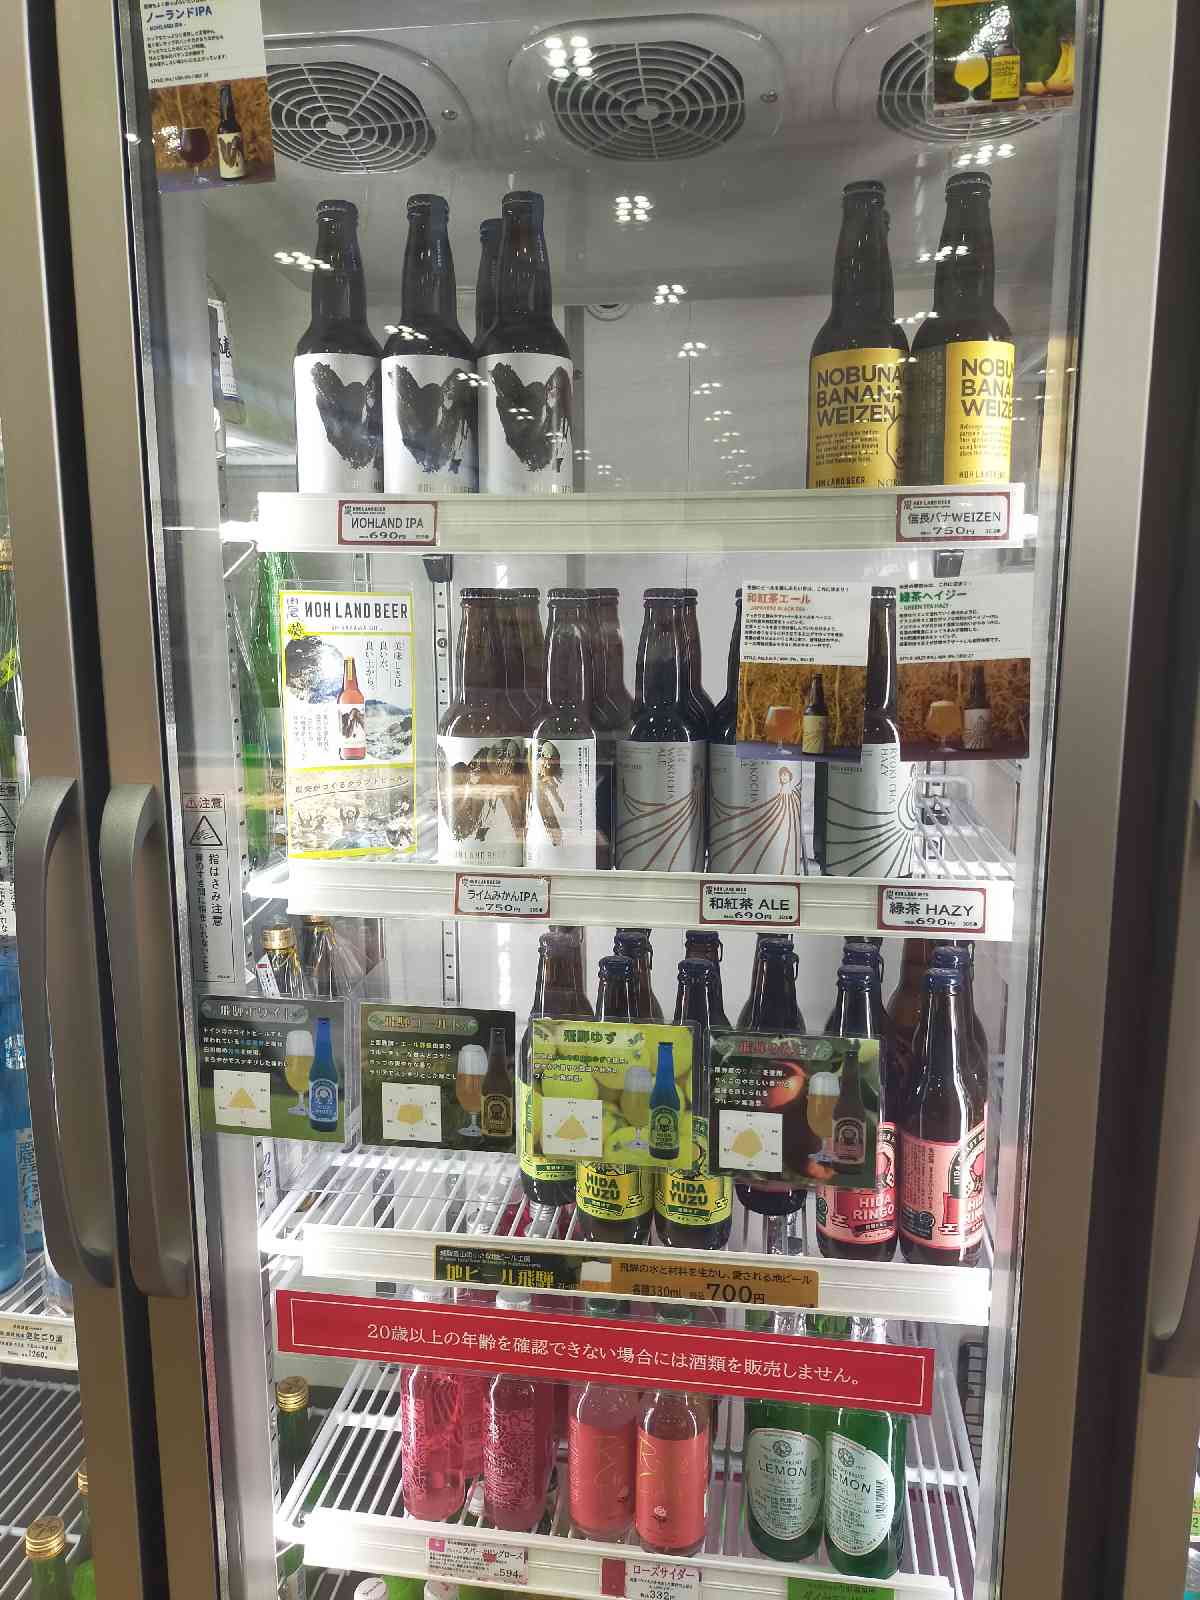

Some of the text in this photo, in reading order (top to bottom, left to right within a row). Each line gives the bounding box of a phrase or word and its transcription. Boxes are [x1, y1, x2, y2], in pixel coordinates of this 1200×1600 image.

[146, 5, 213, 23] ノーランドIPA
[816, 404, 897, 428] WEIZEN
[405, 517, 424, 529] IPA
[908, 511, 1001, 525] 信長バナWEIZEN
[746, 592, 811, 605] 和紅茶エール
[900, 590, 967, 603] 緑茶ヘイジー
[335, 602, 371, 619] LAND
[374, 603, 408, 619] BEER
[880, 748, 889, 777] HAZY
[208, 853, 223, 927] 指はさみ注意
[467, 889, 538, 902] ライムみかんIPA
[709, 896, 790, 911] 和紅茶 ALE
[889, 901, 974, 917] 緑茶 HAZY
[586, 1172, 619, 1189] HIDA
[671, 1180, 705, 1194] HIDA
[585, 1182, 620, 1200] YUZU
[670, 1190, 708, 1206] YUZU
[858, 1194, 892, 1208] HIDA
[852, 1204, 895, 1222] RINGO
[706, 1283, 766, 1304] 700円
[367, 1323, 861, 1386] 20歳以上の年齢を確認できない場合には酒類を販売しません。
[758, 1459, 808, 1477] LEMON
[633, 1565, 695, 1580] ローズサイダー
